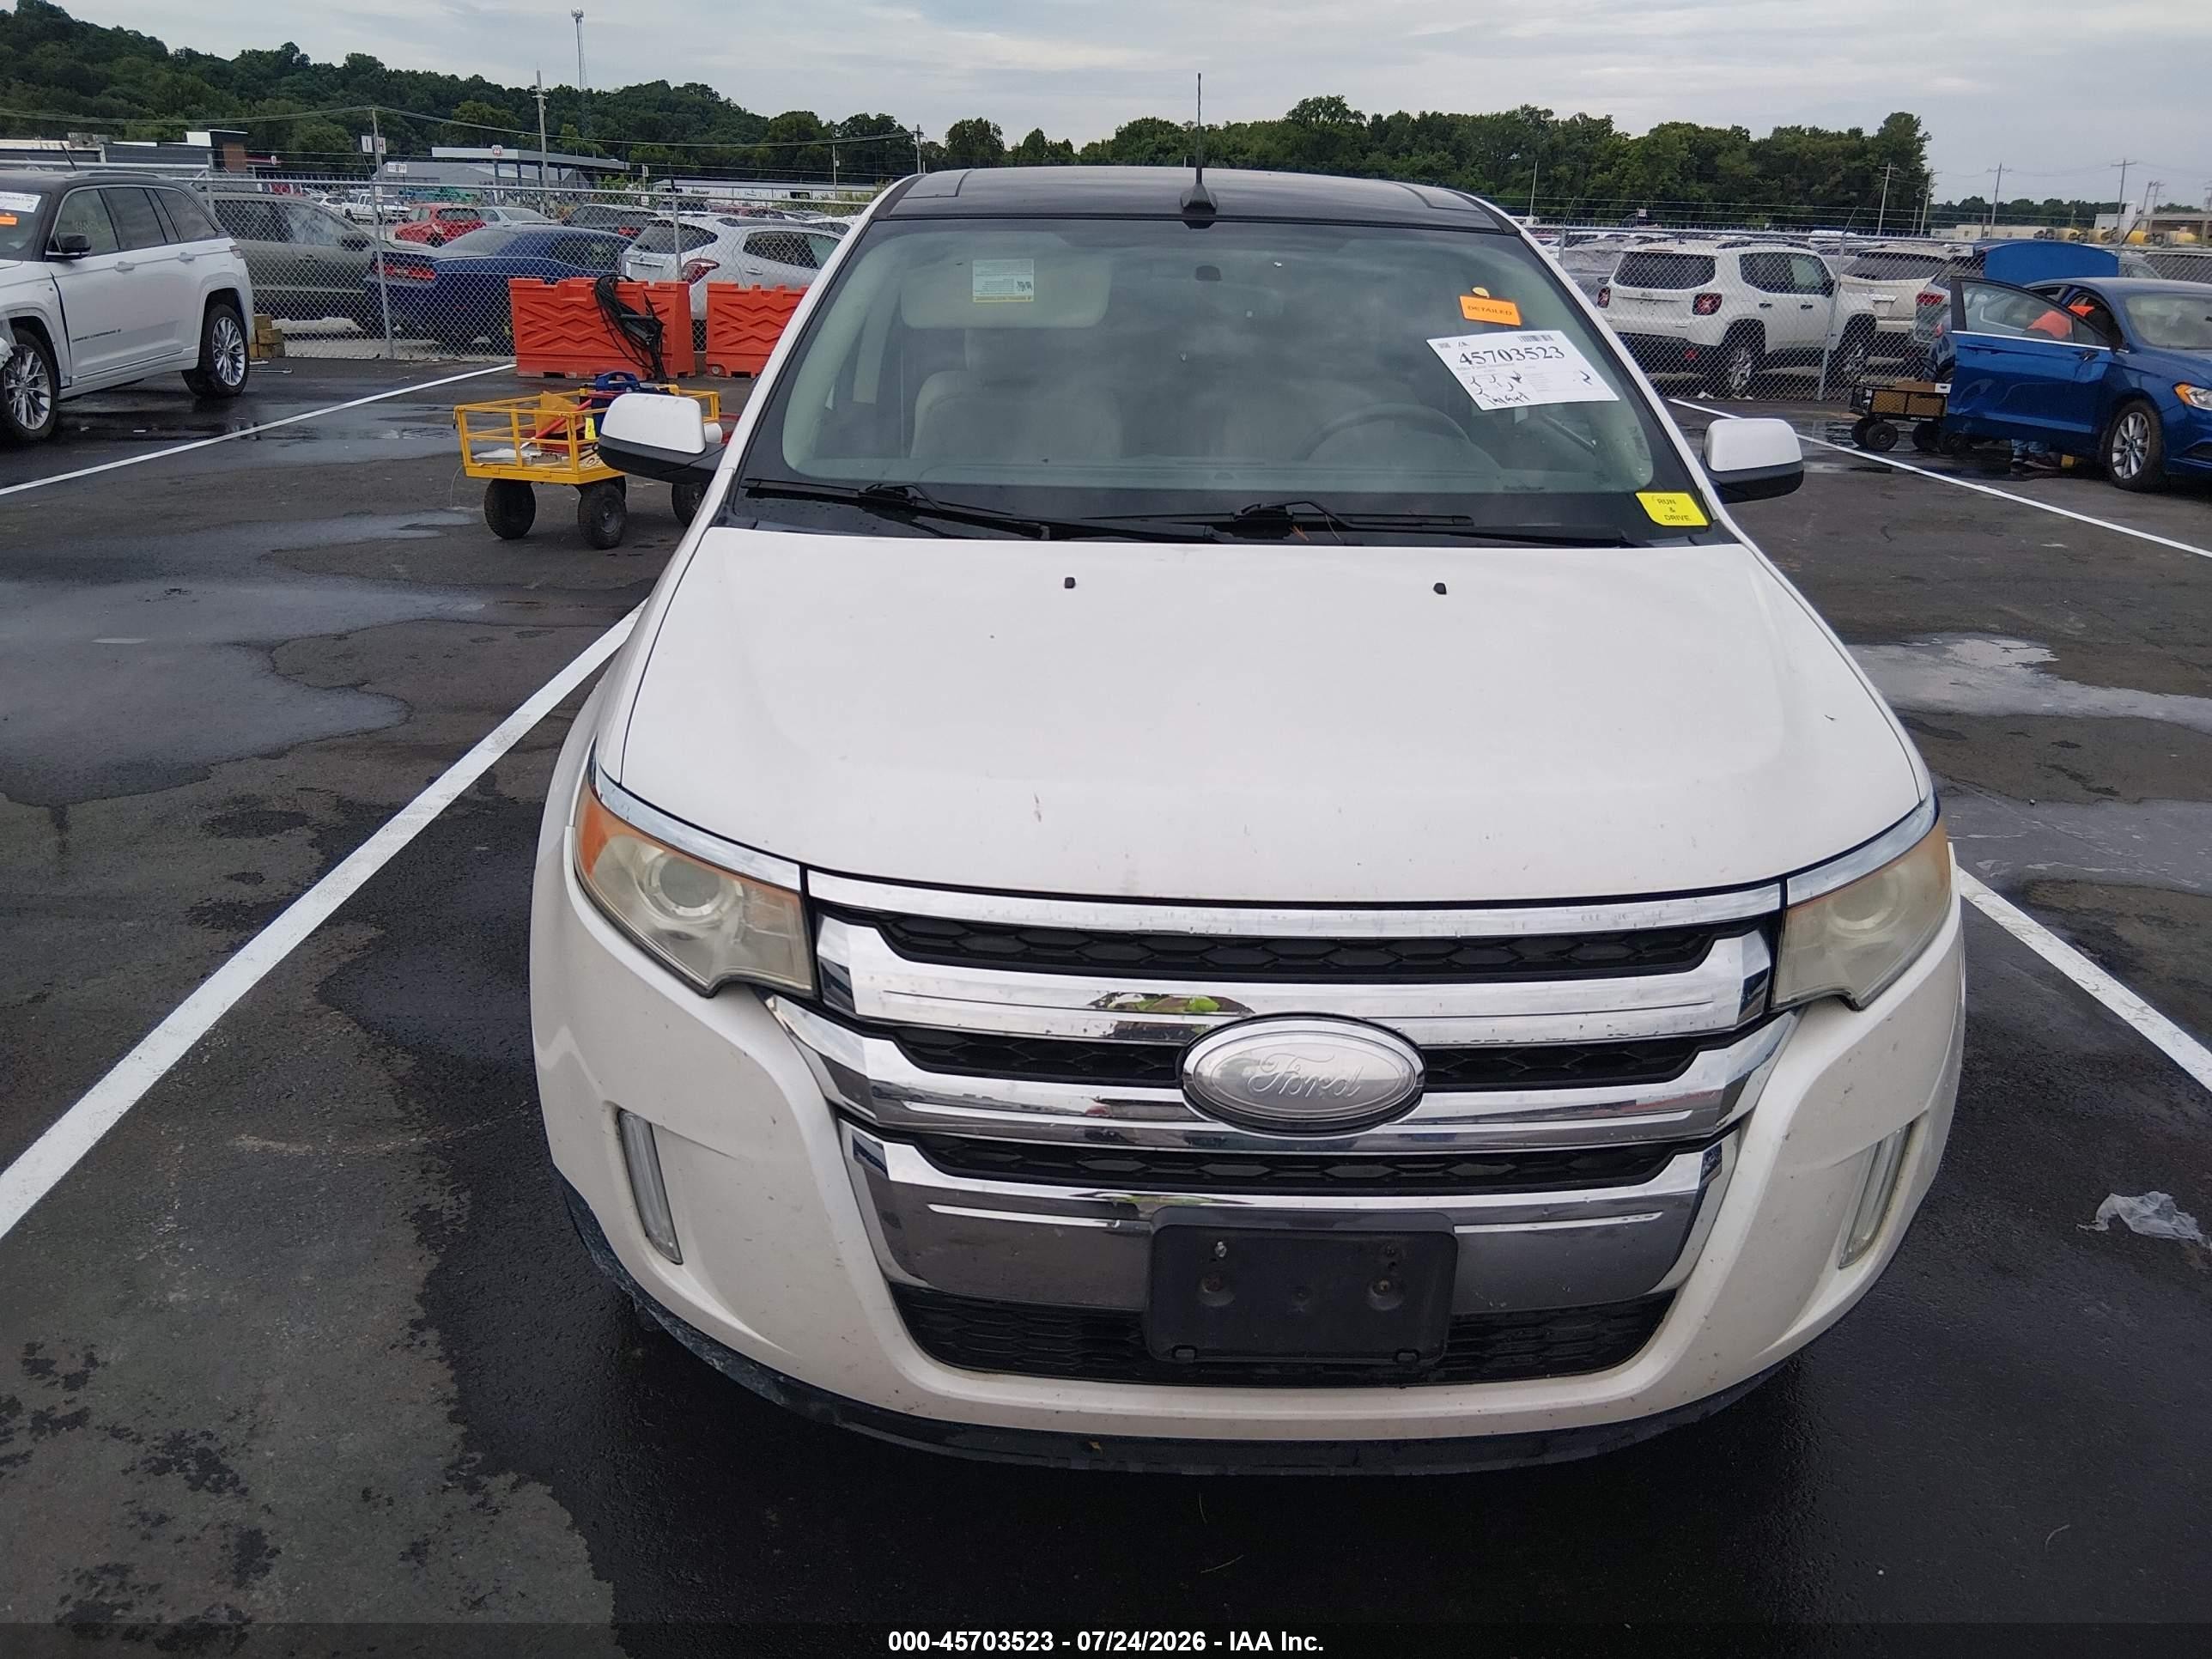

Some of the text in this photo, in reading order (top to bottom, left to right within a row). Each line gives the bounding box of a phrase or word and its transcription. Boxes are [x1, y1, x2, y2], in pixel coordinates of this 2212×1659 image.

[378, 139, 385, 151] H
[1467, 305, 1512, 316] DETAILED
[1458, 346, 1565, 365] 45703523
[1246, 1052, 1364, 1098] Ford
